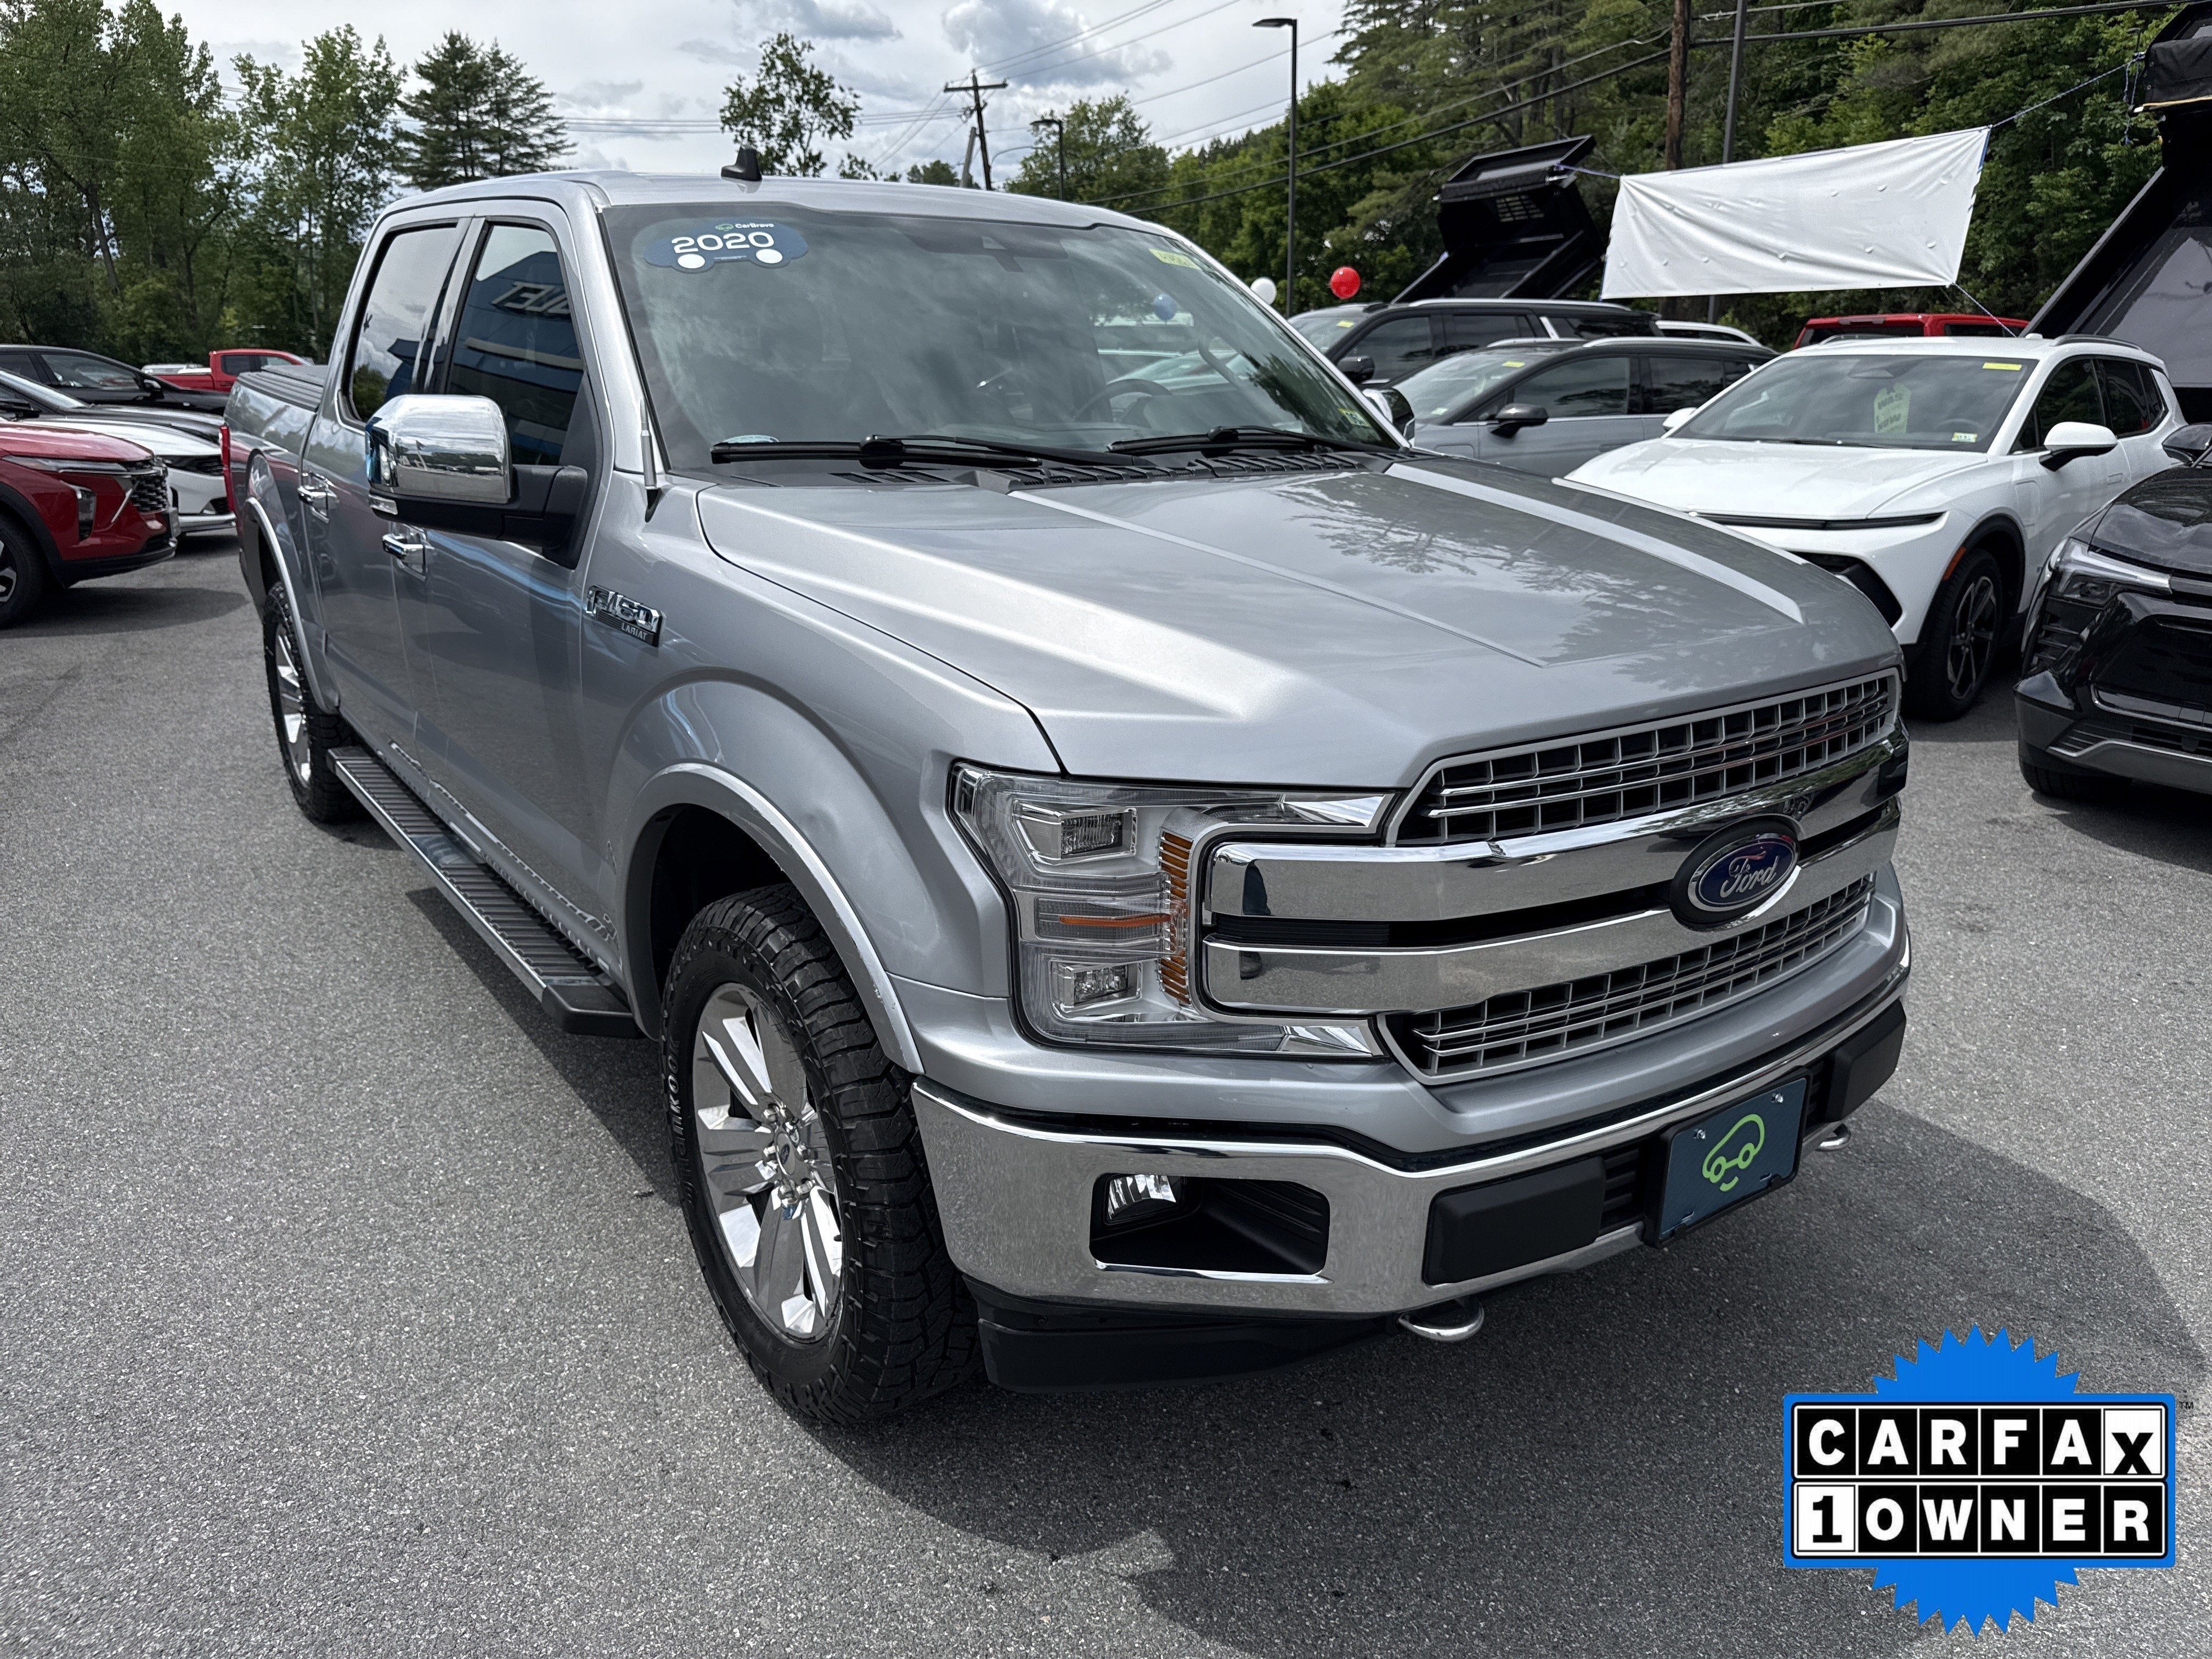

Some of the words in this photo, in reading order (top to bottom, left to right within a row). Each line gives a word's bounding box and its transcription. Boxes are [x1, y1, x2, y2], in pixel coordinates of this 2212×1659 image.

[671, 231, 775, 254] 2020
[620, 622, 648, 641] LARIAT
[1719, 850, 1780, 899] Ford
